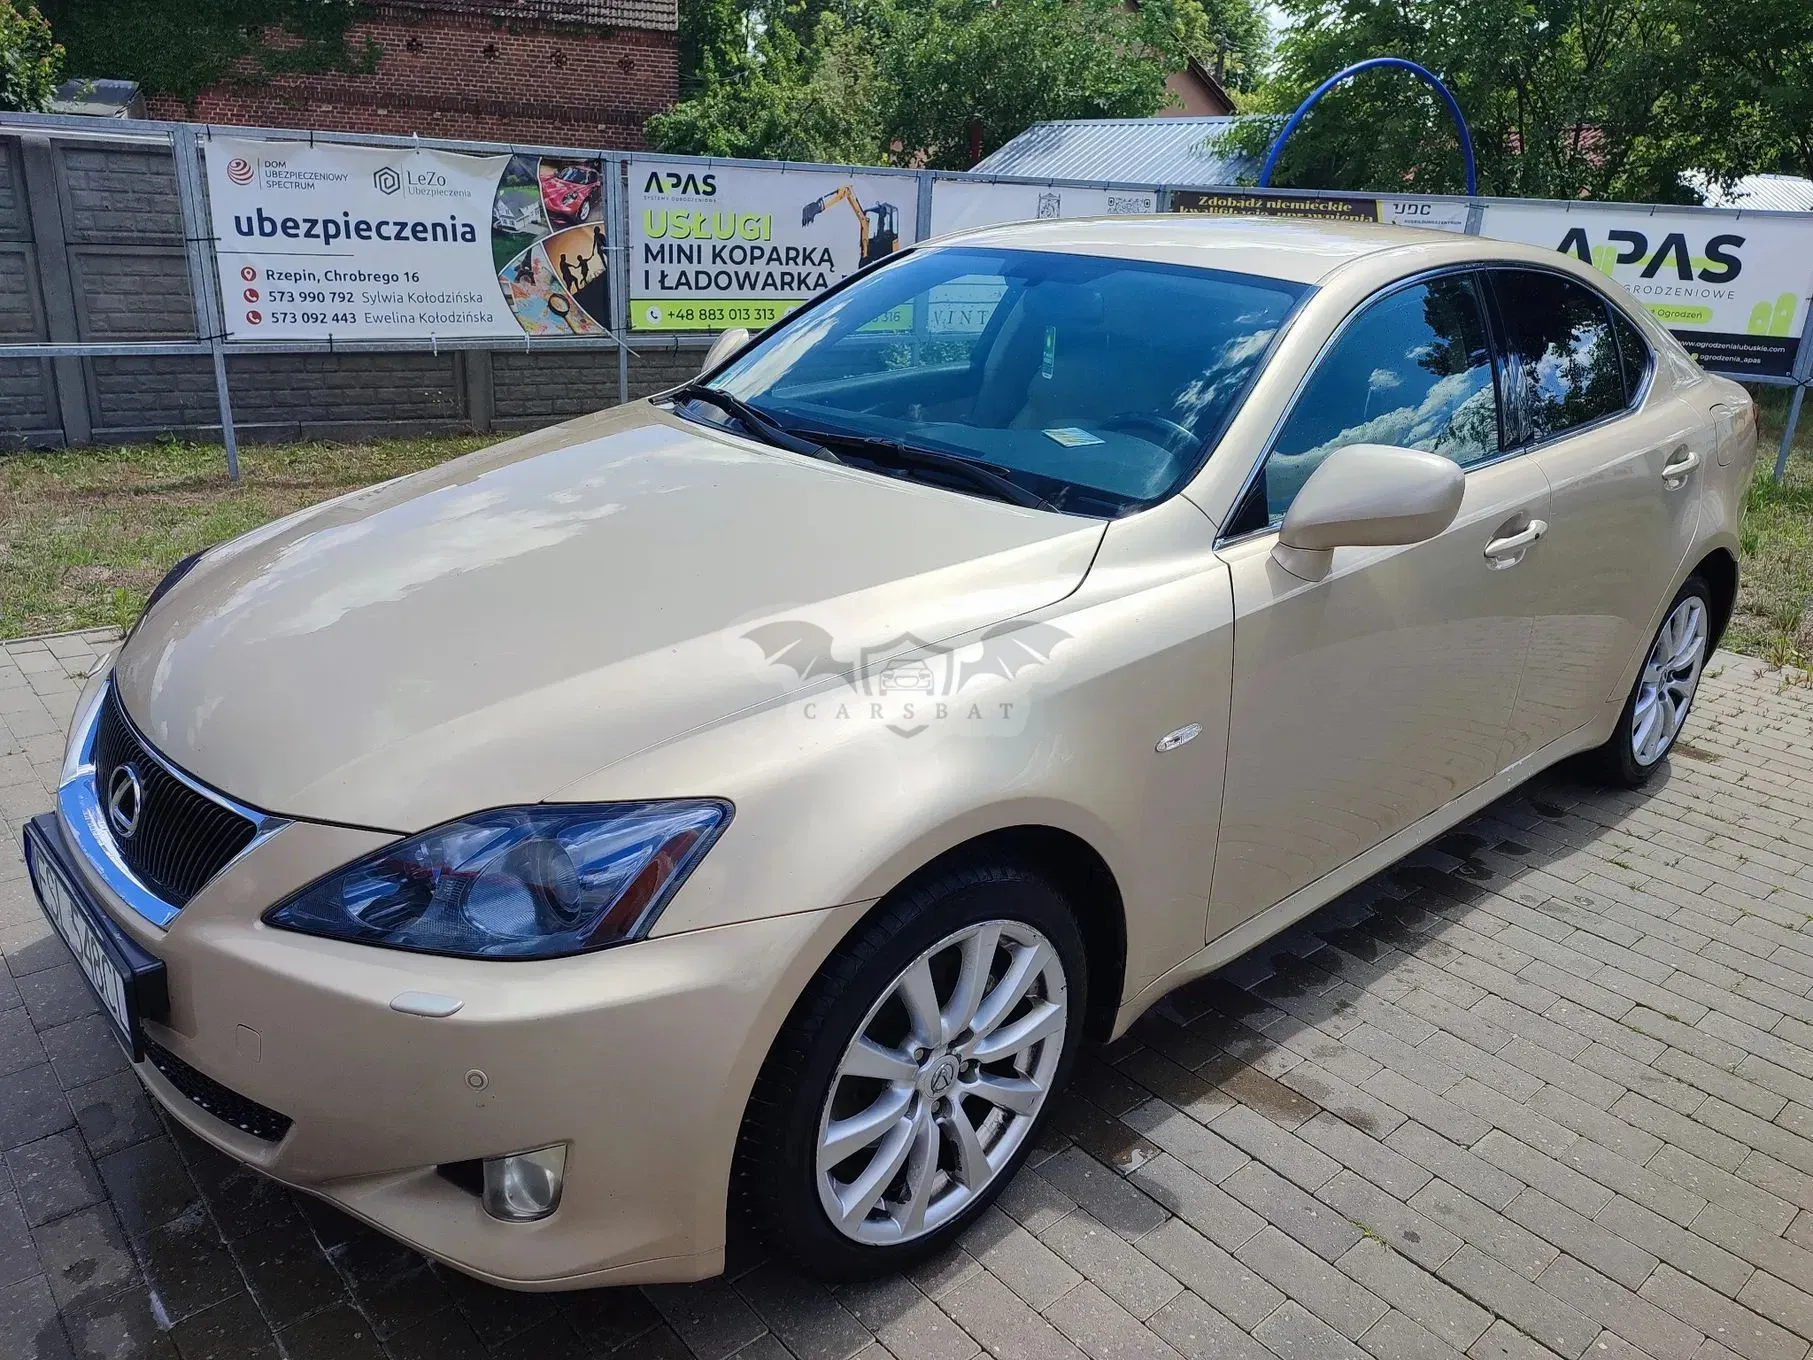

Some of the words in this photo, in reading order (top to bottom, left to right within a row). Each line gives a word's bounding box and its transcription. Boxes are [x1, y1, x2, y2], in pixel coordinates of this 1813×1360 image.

[264, 160, 287, 169] DOM
[265, 170, 348, 182] UBEZPIECZENIOWY
[407, 171, 446, 187] LeZo
[644, 171, 717, 196] APAS
[266, 181, 316, 190] SPECTRUM
[408, 186, 472, 198] Ubezpieczenia
[1266, 199, 1353, 212] niemieckie
[233, 207, 477, 246] ubezpieczenia
[643, 207, 772, 242] USŁUGI
[644, 243, 702, 265] MINI
[711, 244, 835, 273] KOPARKĄ
[1556, 227, 1747, 284] APAS
[265, 269, 321, 284] Rzepin,
[324, 270, 399, 285] Chrobrego
[403, 271, 420, 283] 16
[643, 269, 650, 291] I
[268, 291, 295, 303] 573
[299, 291, 326, 303] 990
[329, 291, 355, 303] 792
[361, 291, 404, 306] Sylwia
[408, 291, 483, 304] Kołodzińska
[271, 312, 297, 324] 573
[301, 312, 328, 324] 092
[331, 312, 357, 324] 443
[364, 312, 415, 324] Ewelina
[419, 312, 494, 324] Kołodzińska
[667, 308, 695, 321] +48
[698, 308, 725, 321] 883
[728, 308, 751, 321] 013
[754, 308, 775, 321] 313
